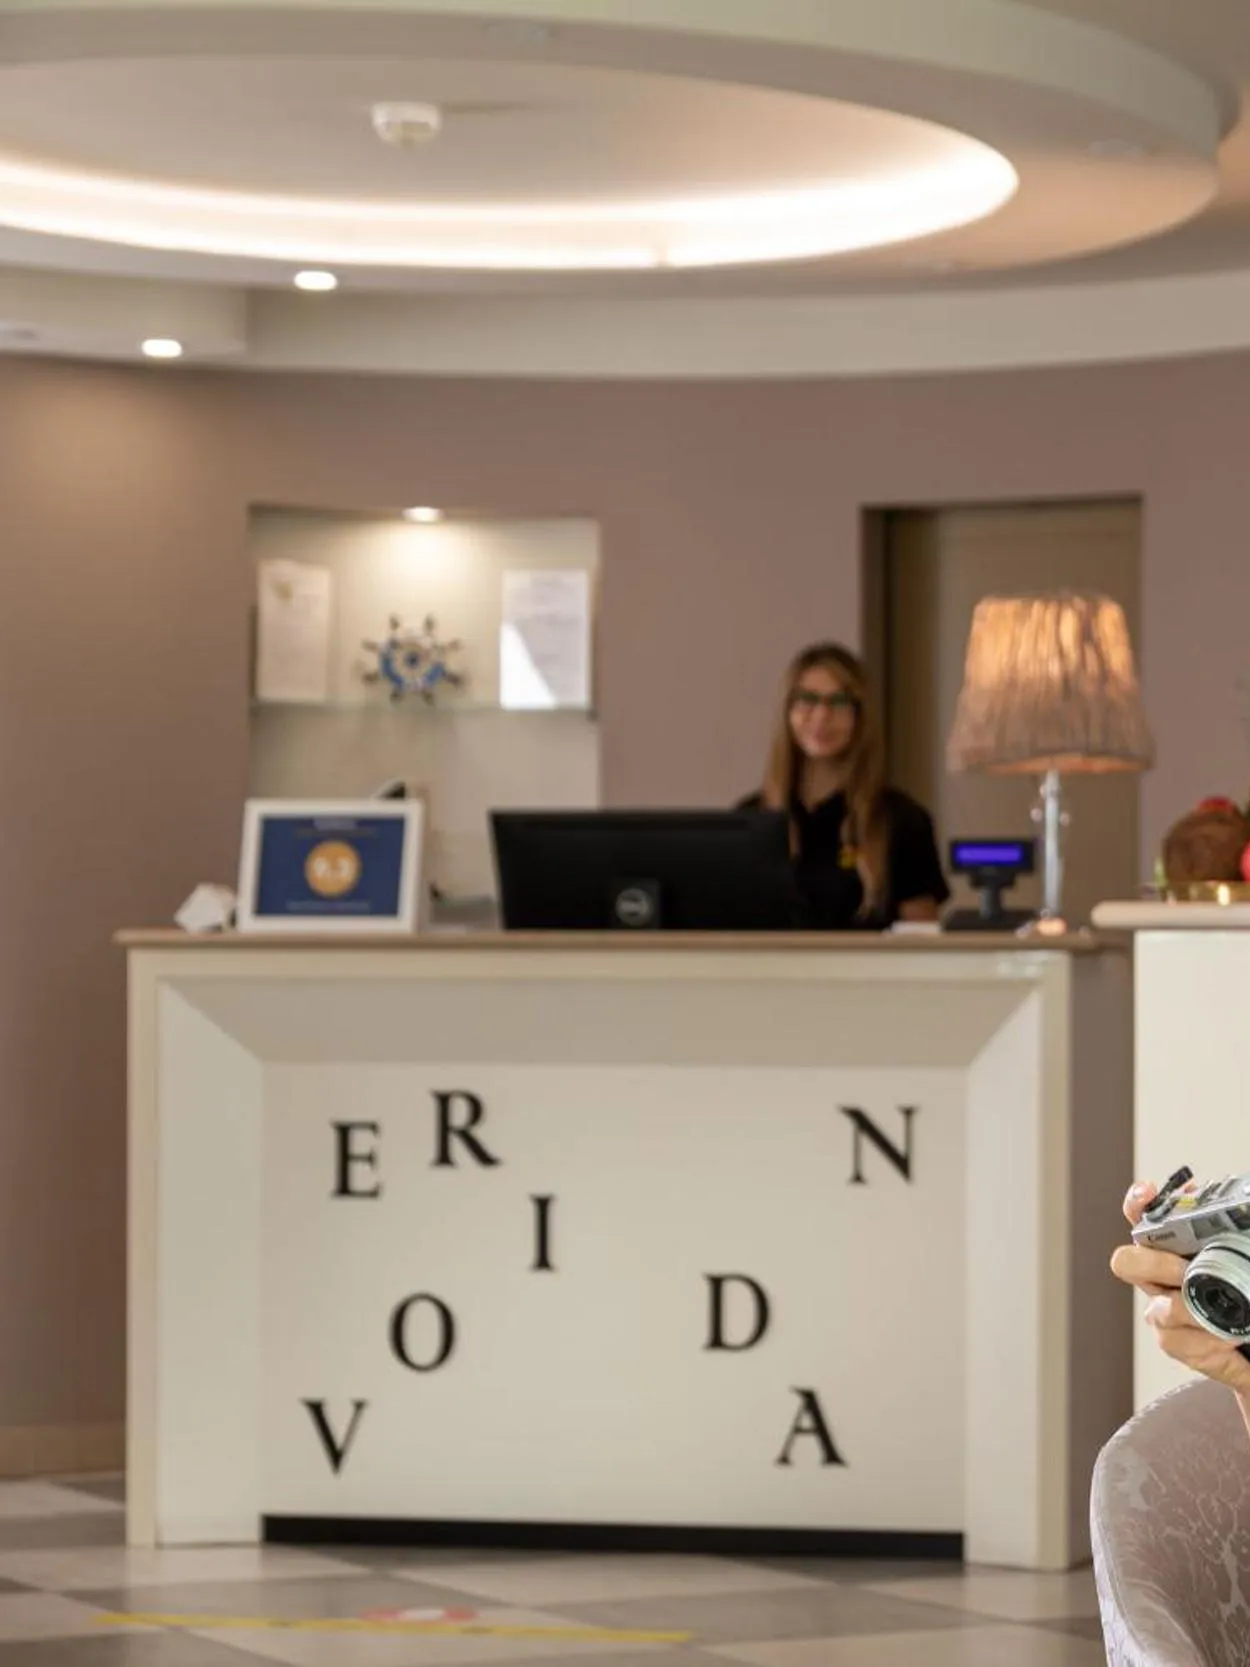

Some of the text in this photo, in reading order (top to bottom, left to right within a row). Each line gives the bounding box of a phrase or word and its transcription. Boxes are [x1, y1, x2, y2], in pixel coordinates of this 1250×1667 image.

[330, 1119, 383, 1200] E
[430, 1089, 502, 1169] R
[839, 1105, 919, 1185] N
[529, 1193, 556, 1272] I
[388, 1292, 457, 1374] O
[703, 1273, 771, 1352] D
[300, 1398, 368, 1476] V
[776, 1387, 849, 1468] A
